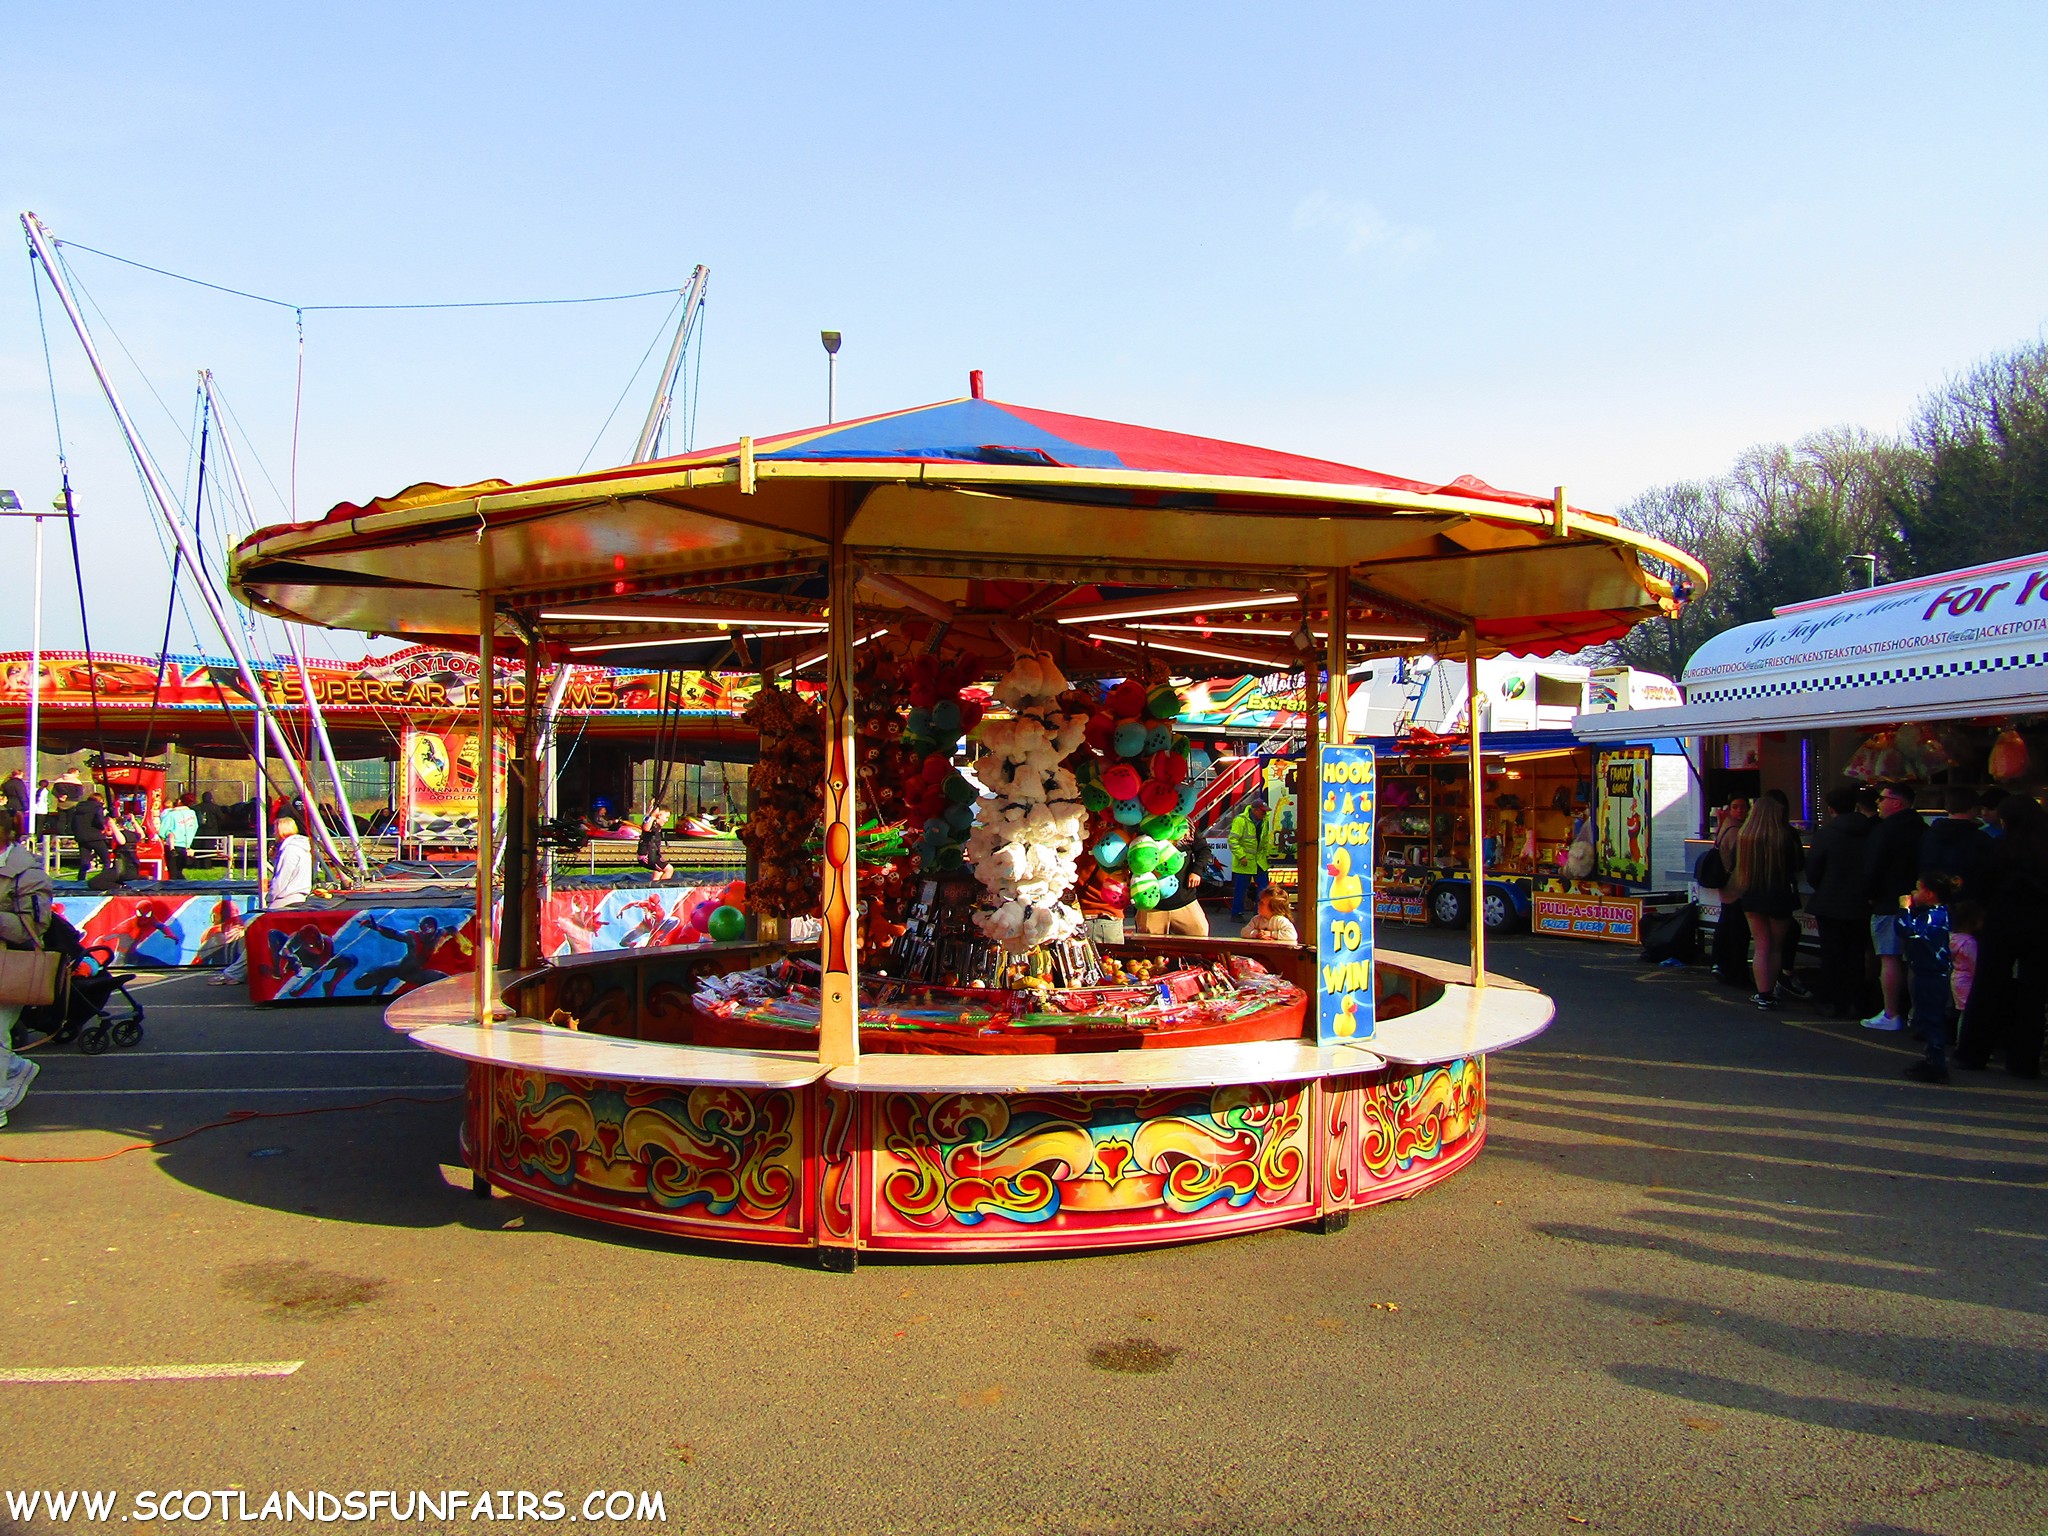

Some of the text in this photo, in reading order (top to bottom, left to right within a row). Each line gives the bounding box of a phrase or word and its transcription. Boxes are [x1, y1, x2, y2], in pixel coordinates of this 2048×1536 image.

[1922, 581, 2012, 621] For
[283, 680, 614, 705] SUPERCAR DODMS
[1323, 761, 1373, 784] HOOK
[1341, 791, 1355, 815] A
[1325, 821, 1370, 846] DUCK
[1540, 902, 1634, 921] PULL-A-STRING
[1331, 919, 1362, 953] TO
[1541, 918, 1633, 935] PRIZE EVERY TIME
[1322, 959, 1370, 995] WIN
